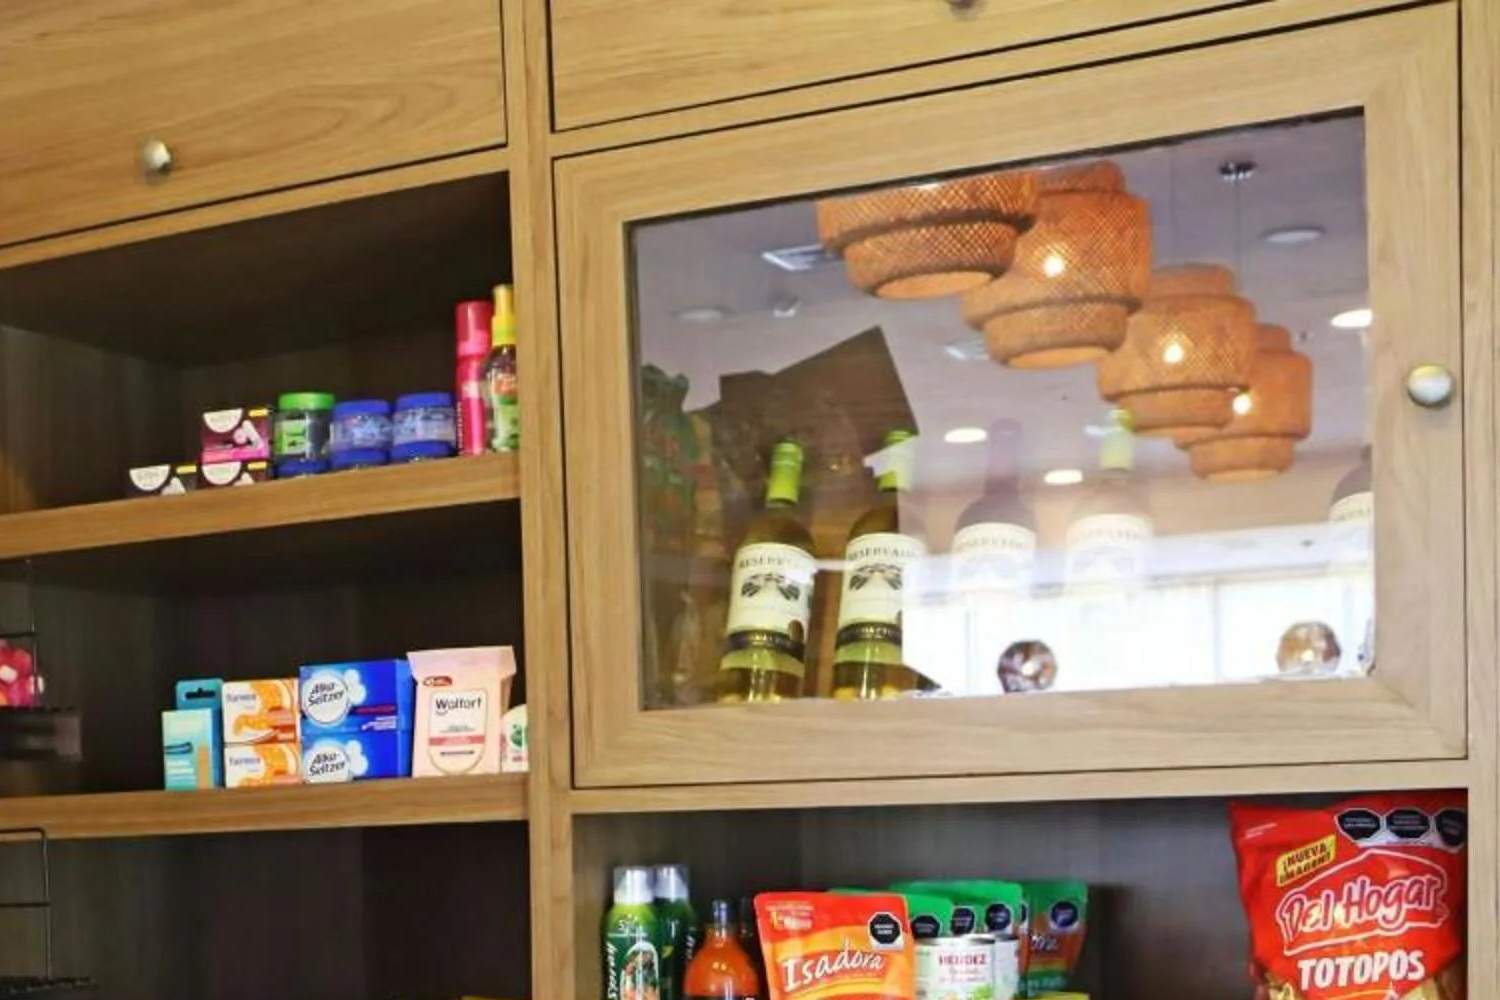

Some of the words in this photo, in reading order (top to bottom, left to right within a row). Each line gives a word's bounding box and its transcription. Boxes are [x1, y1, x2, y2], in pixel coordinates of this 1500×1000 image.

[1276, 891, 1334, 944] Del
[1341, 876, 1445, 924] Hogar
[781, 937, 886, 992] Isadora
[1297, 950, 1425, 991] TOTOPOS
